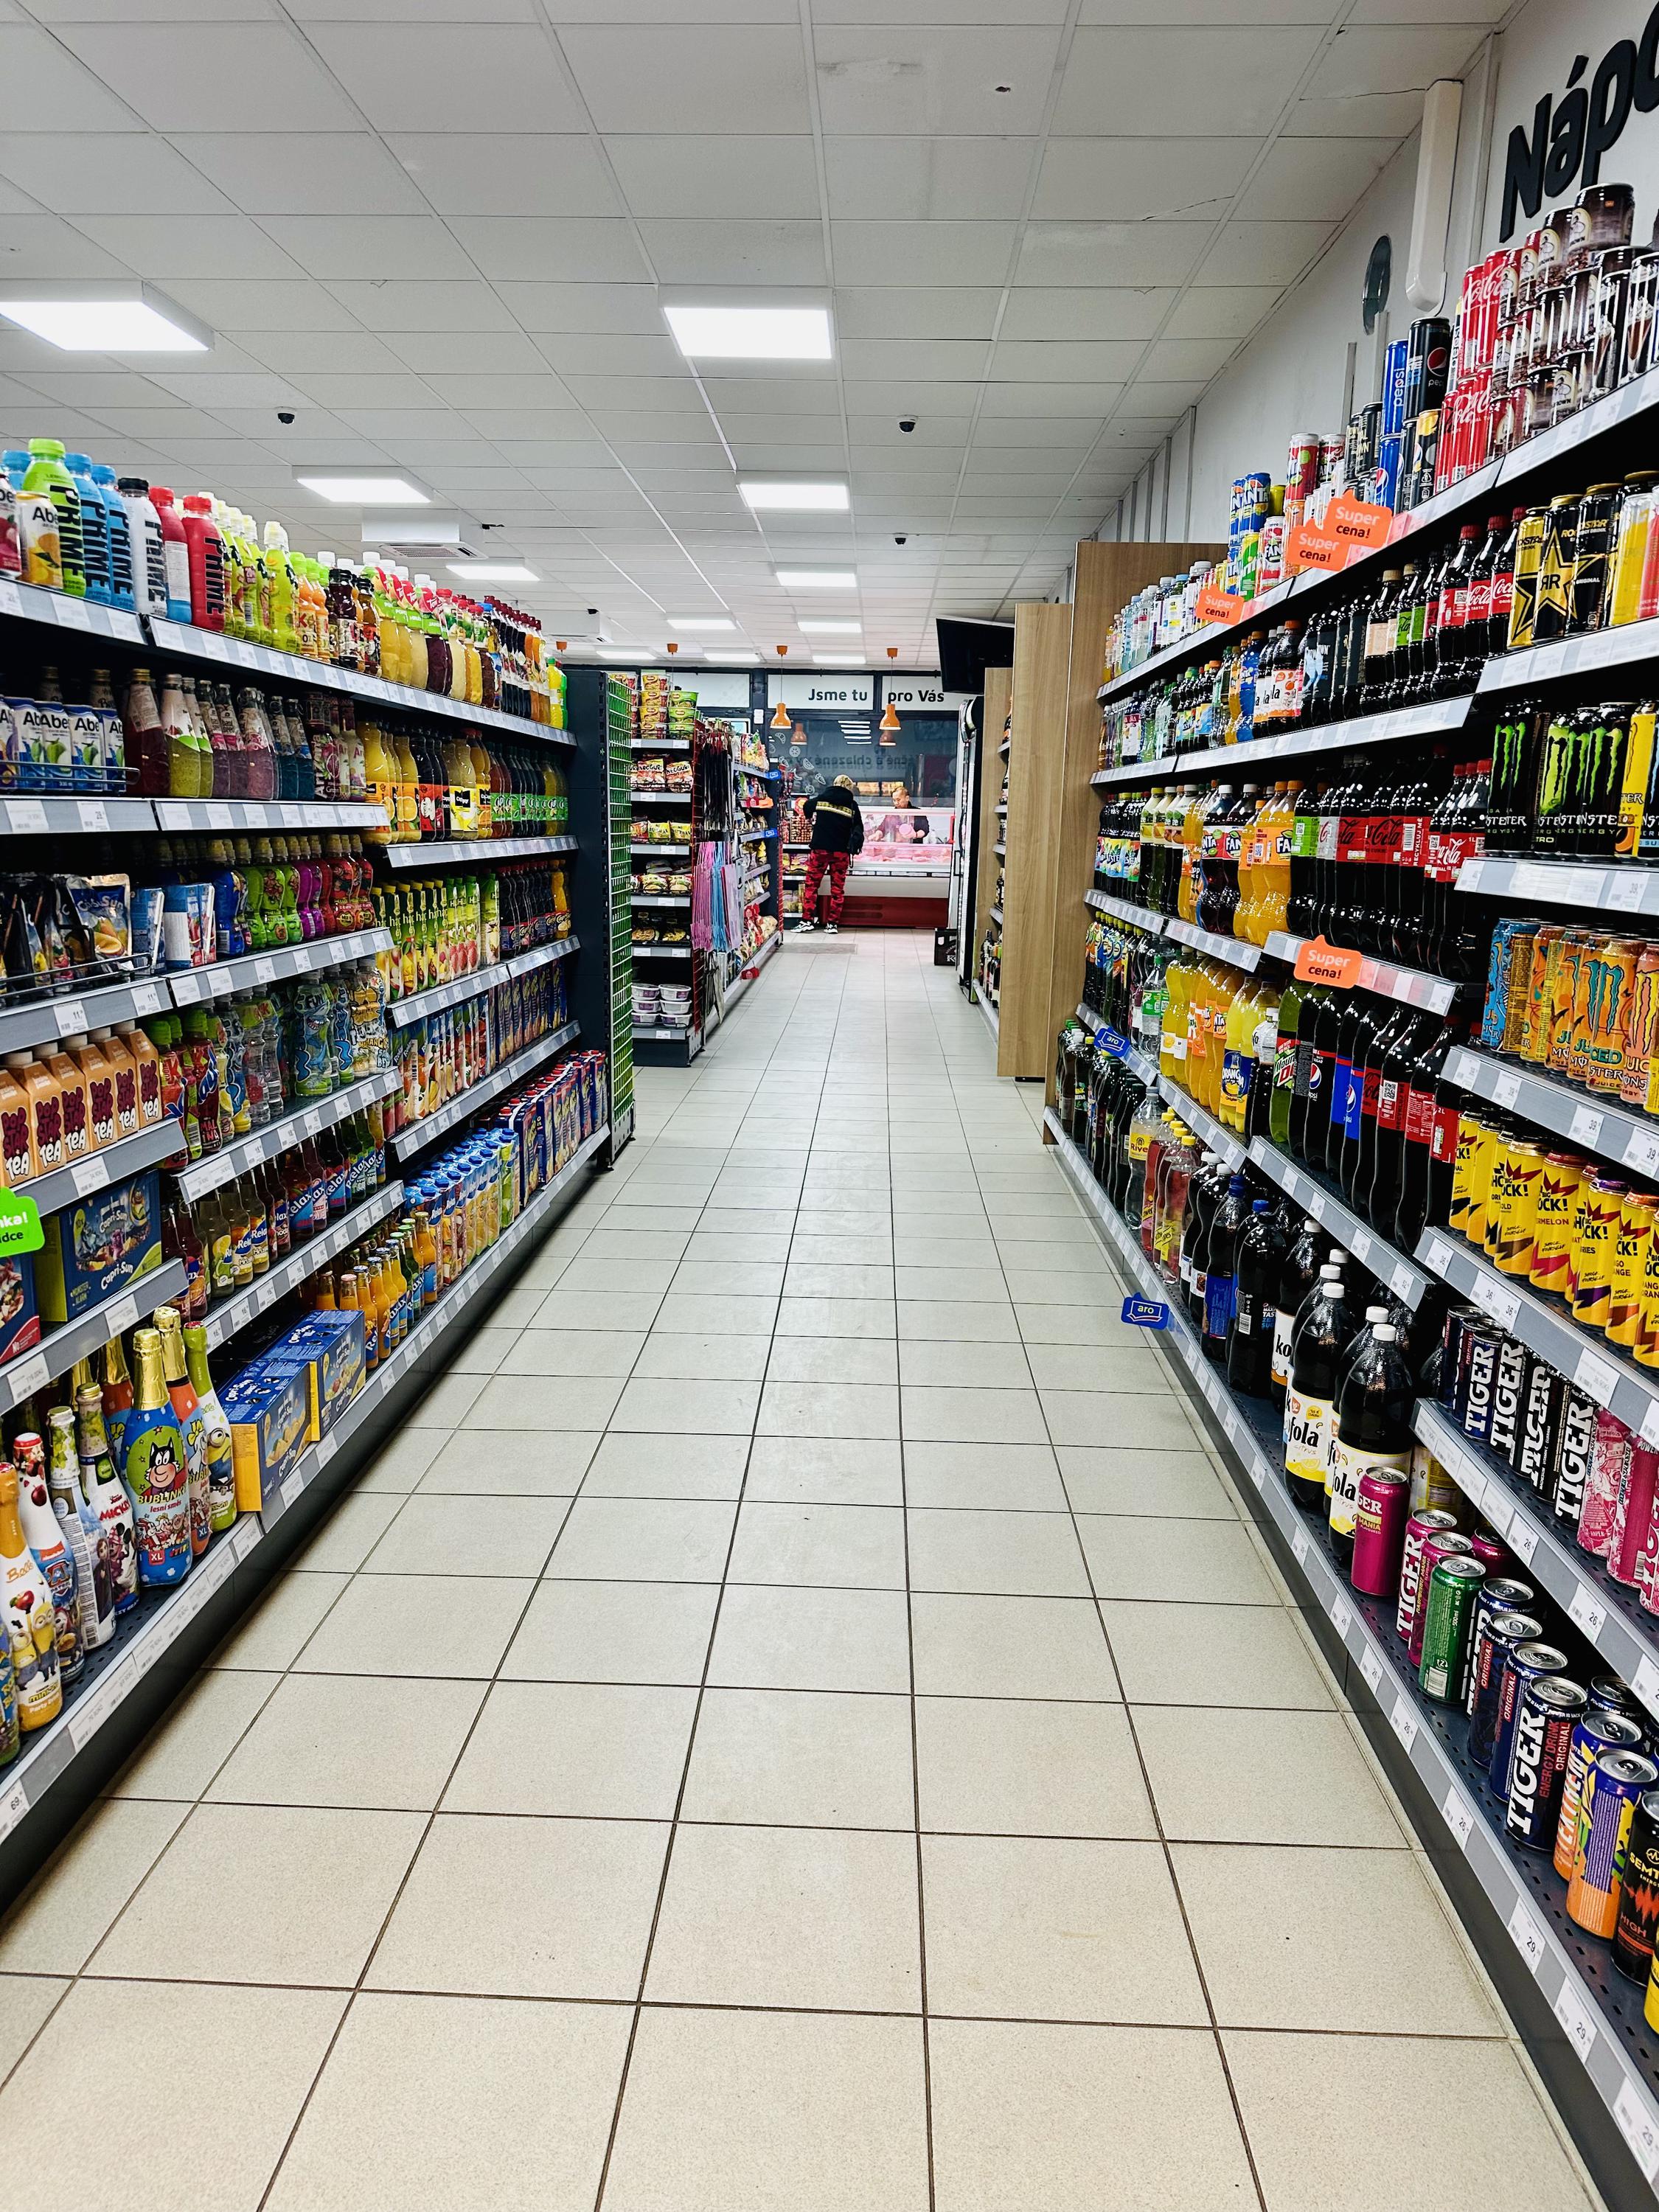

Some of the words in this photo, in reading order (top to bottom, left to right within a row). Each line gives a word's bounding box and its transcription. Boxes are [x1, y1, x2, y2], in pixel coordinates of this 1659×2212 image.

[1394, 367, 1405, 407] pepsi
[1335, 506, 1380, 526] Super
[49, 484, 86, 580] PRIME
[81, 499, 111, 588] PRIME
[1298, 532, 1340, 551] Super
[1335, 524, 1371, 539] cena!
[109, 509, 133, 595] PRIME
[145, 520, 166, 602] PRIME
[1299, 549, 1332, 563] cena!
[204, 537, 225, 615] PRIME
[1205, 594, 1237, 610] Super
[1205, 606, 1230, 619] cena!
[808, 688, 847, 701] Jsme
[852, 689, 868, 700] tu
[888, 691, 913, 704] pro
[917, 689, 945, 702] Vás
[1413, 830, 1421, 866] RECYKLUJ
[1307, 947, 1351, 969] Super
[1307, 964, 1342, 980] cena!
[1107, 1034, 1119, 1044] aro
[100, 1210, 128, 1234] Capri-Sun
[101, 1261, 133, 1290] Capri-Sun
[1137, 1305, 1154, 1314] aro
[1276, 1334, 1291, 1357] ko
[1464, 1345, 1496, 1433] TIGER
[1489, 1341, 1525, 1450] TIGER
[1554, 1400, 1595, 1521] TIGER
[150, 1503, 167, 1514] lesní
[167, 1499, 182, 1510] směs
[198, 1527, 208, 1537] XL
[151, 1552, 163, 1561] XL
[1481, 1644, 1492, 1688] ORIGINAL
[1504, 1674, 1516, 1722] ORIGINAL
[1545, 1719, 1559, 1757] DRINK
[1555, 1722, 1571, 1770] ORIGINAL
[1506, 1705, 1545, 1836] TIGER
[1539, 1758, 1554, 1799] ENERGY
[1620, 1913, 1647, 1938] HIGH
